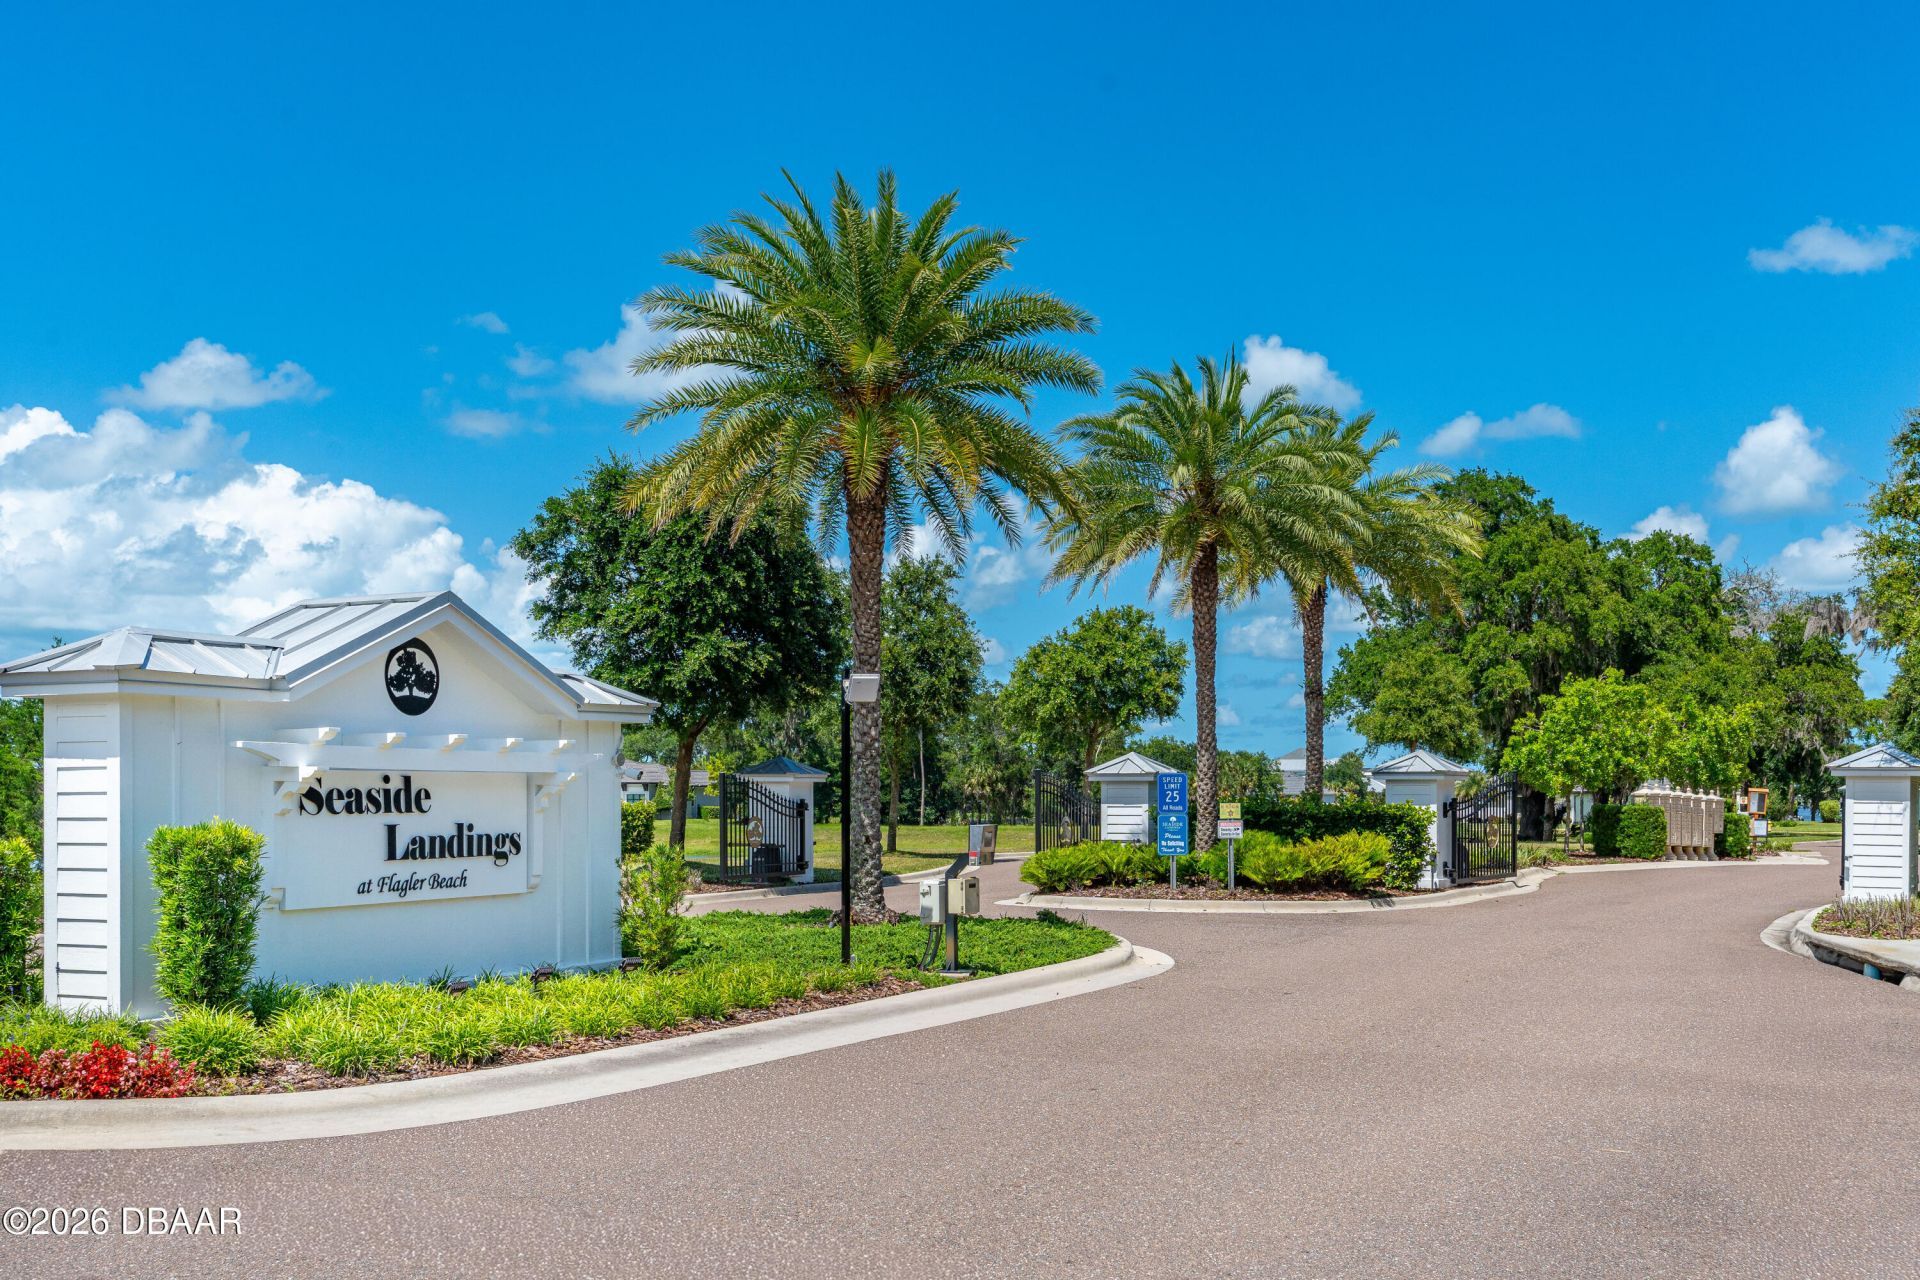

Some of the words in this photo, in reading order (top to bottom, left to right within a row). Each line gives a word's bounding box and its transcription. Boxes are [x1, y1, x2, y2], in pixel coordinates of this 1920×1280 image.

[299, 774, 432, 816] Seaside
[1165, 790, 1180, 803] 25
[384, 822, 522, 867] Landings
[357, 878, 373, 895] at
[377, 871, 426, 898] Flagler
[428, 869, 468, 890] Beach
